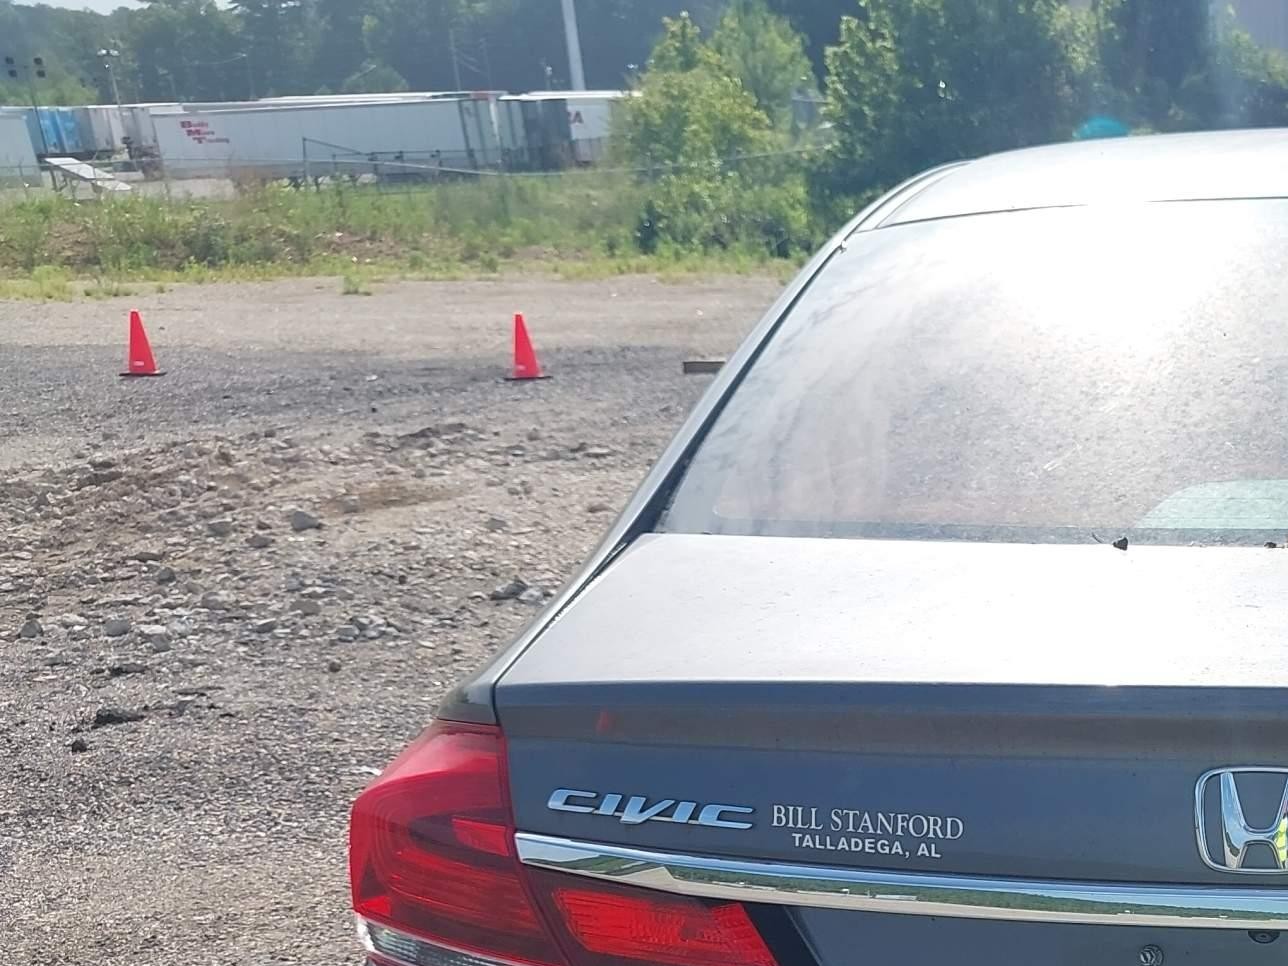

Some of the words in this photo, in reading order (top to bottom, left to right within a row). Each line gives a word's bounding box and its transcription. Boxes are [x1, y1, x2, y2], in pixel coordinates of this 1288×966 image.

[547, 788, 753, 829] CIVIC
[771, 804, 823, 831] BILL
[830, 808, 964, 840] STANFORD
[792, 833, 910, 858] TALLADEGA,
[917, 842, 942, 858] AL
